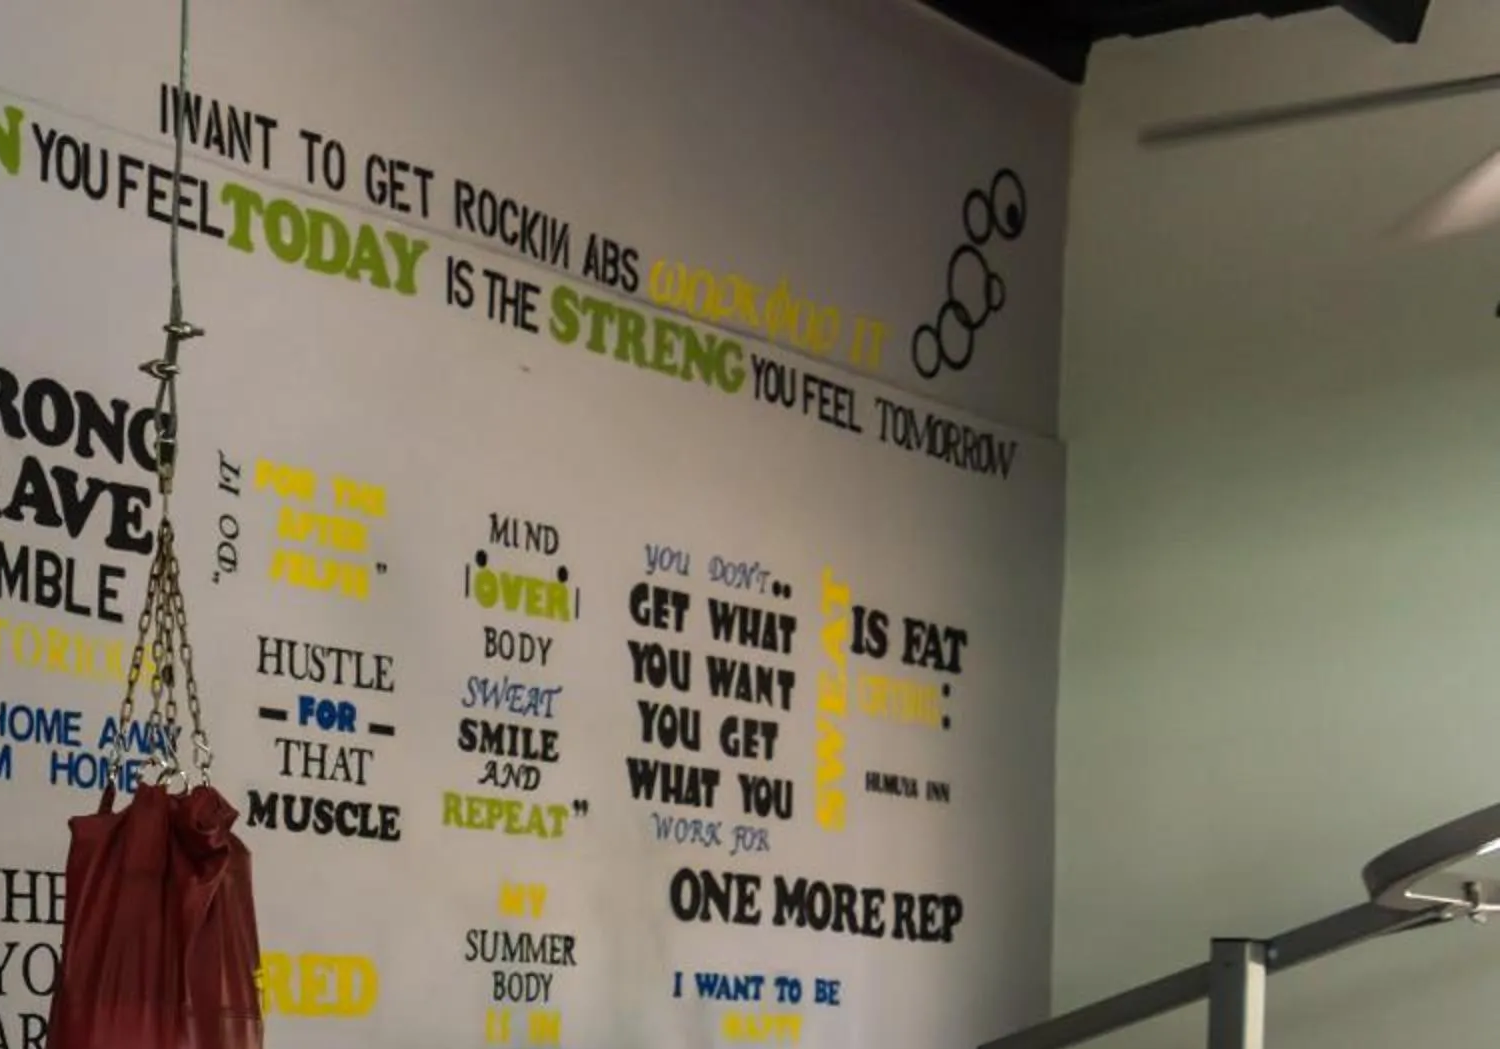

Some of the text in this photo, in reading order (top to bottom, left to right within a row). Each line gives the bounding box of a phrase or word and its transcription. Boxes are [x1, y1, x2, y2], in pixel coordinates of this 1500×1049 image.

[300, 129, 346, 192] TO
[366, 153, 435, 218] GET
[455, 179, 570, 269] ROCKIN
[583, 233, 640, 294] ABS
[32, 121, 109, 200] YOU
[117, 154, 225, 239] FEEL
[220, 182, 430, 296] TODAY
[445, 255, 475, 309] IS
[483, 268, 542, 335] THE
[548, 285, 747, 394] STRENG
[750, 353, 797, 408] YOU
[802, 373, 863, 434] FEEL
[874, 396, 1018, 480] TOMORROW
[489, 511, 560, 556] MIND
[644, 542, 690, 577] YOU
[473, 567, 572, 623] OVER
[628, 581, 798, 655] GET WHAT
[483, 625, 554, 667] BODY
[850, 604, 968, 675] IS FAT
[257, 634, 396, 693] HUSTLE
[627, 639, 692, 693] YOU
[705, 655, 796, 712] WANT
[297, 694, 357, 733] FOR
[461, 675, 564, 719] SWEAT
[98, 715, 182, 756] AWAY
[457, 717, 560, 763] SMILE
[637, 699, 779, 762] YOU GET
[50, 750, 143, 795] HOME
[274, 737, 374, 786] THAT
[477, 760, 542, 792] AND
[625, 756, 794, 821] WHAT YOU
[246, 789, 401, 842] MUSCLE
[651, 811, 723, 848] WORK
[669, 866, 965, 944] ONE MORE REP
[464, 928, 577, 967] SUMMER
[258, 952, 379, 1019] RED
[492, 970, 554, 1003] BODY
[672, 971, 841, 1006] I WANT TO BE
